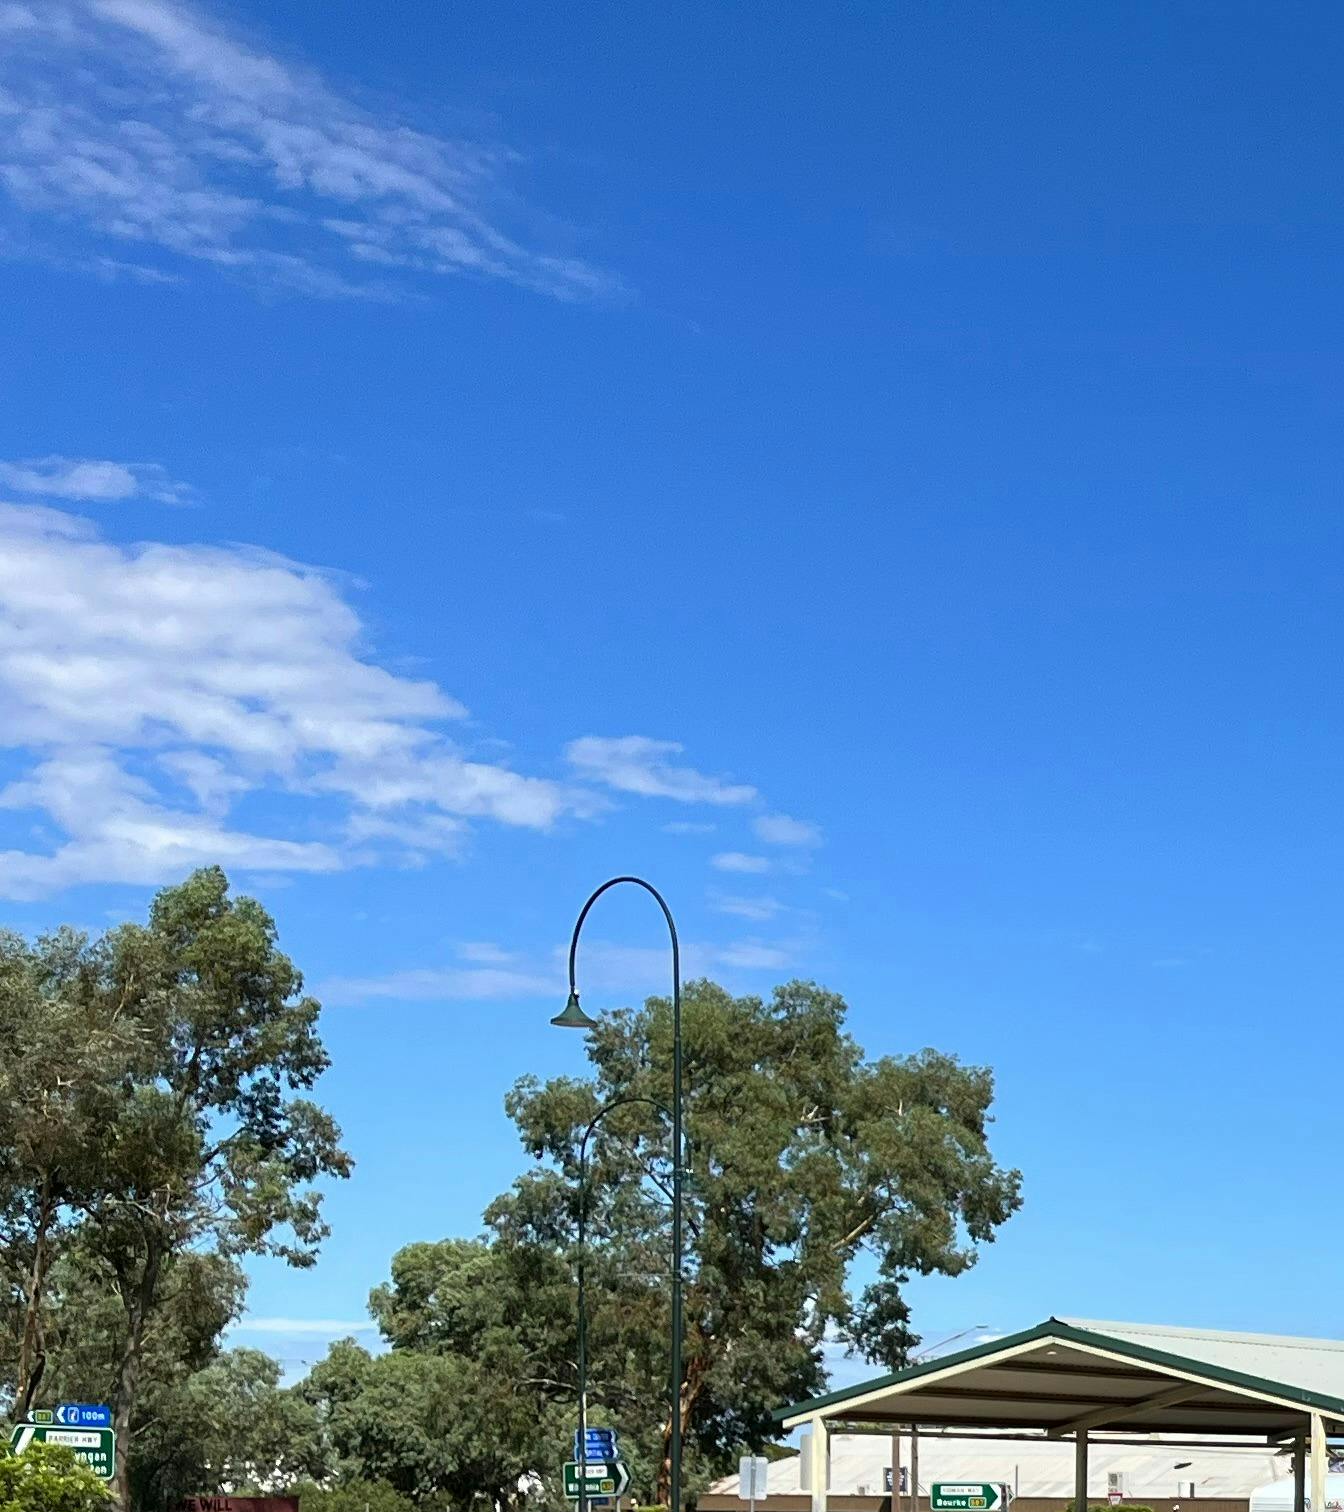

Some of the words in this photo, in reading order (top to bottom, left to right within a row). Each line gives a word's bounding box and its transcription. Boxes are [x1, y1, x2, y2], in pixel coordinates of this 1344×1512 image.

[82, 1411, 105, 1420] 100m
[74, 1452, 107, 1464] yngan
[200, 1498, 232, 1511] WILL
[937, 1498, 967, 1506] Bourke
